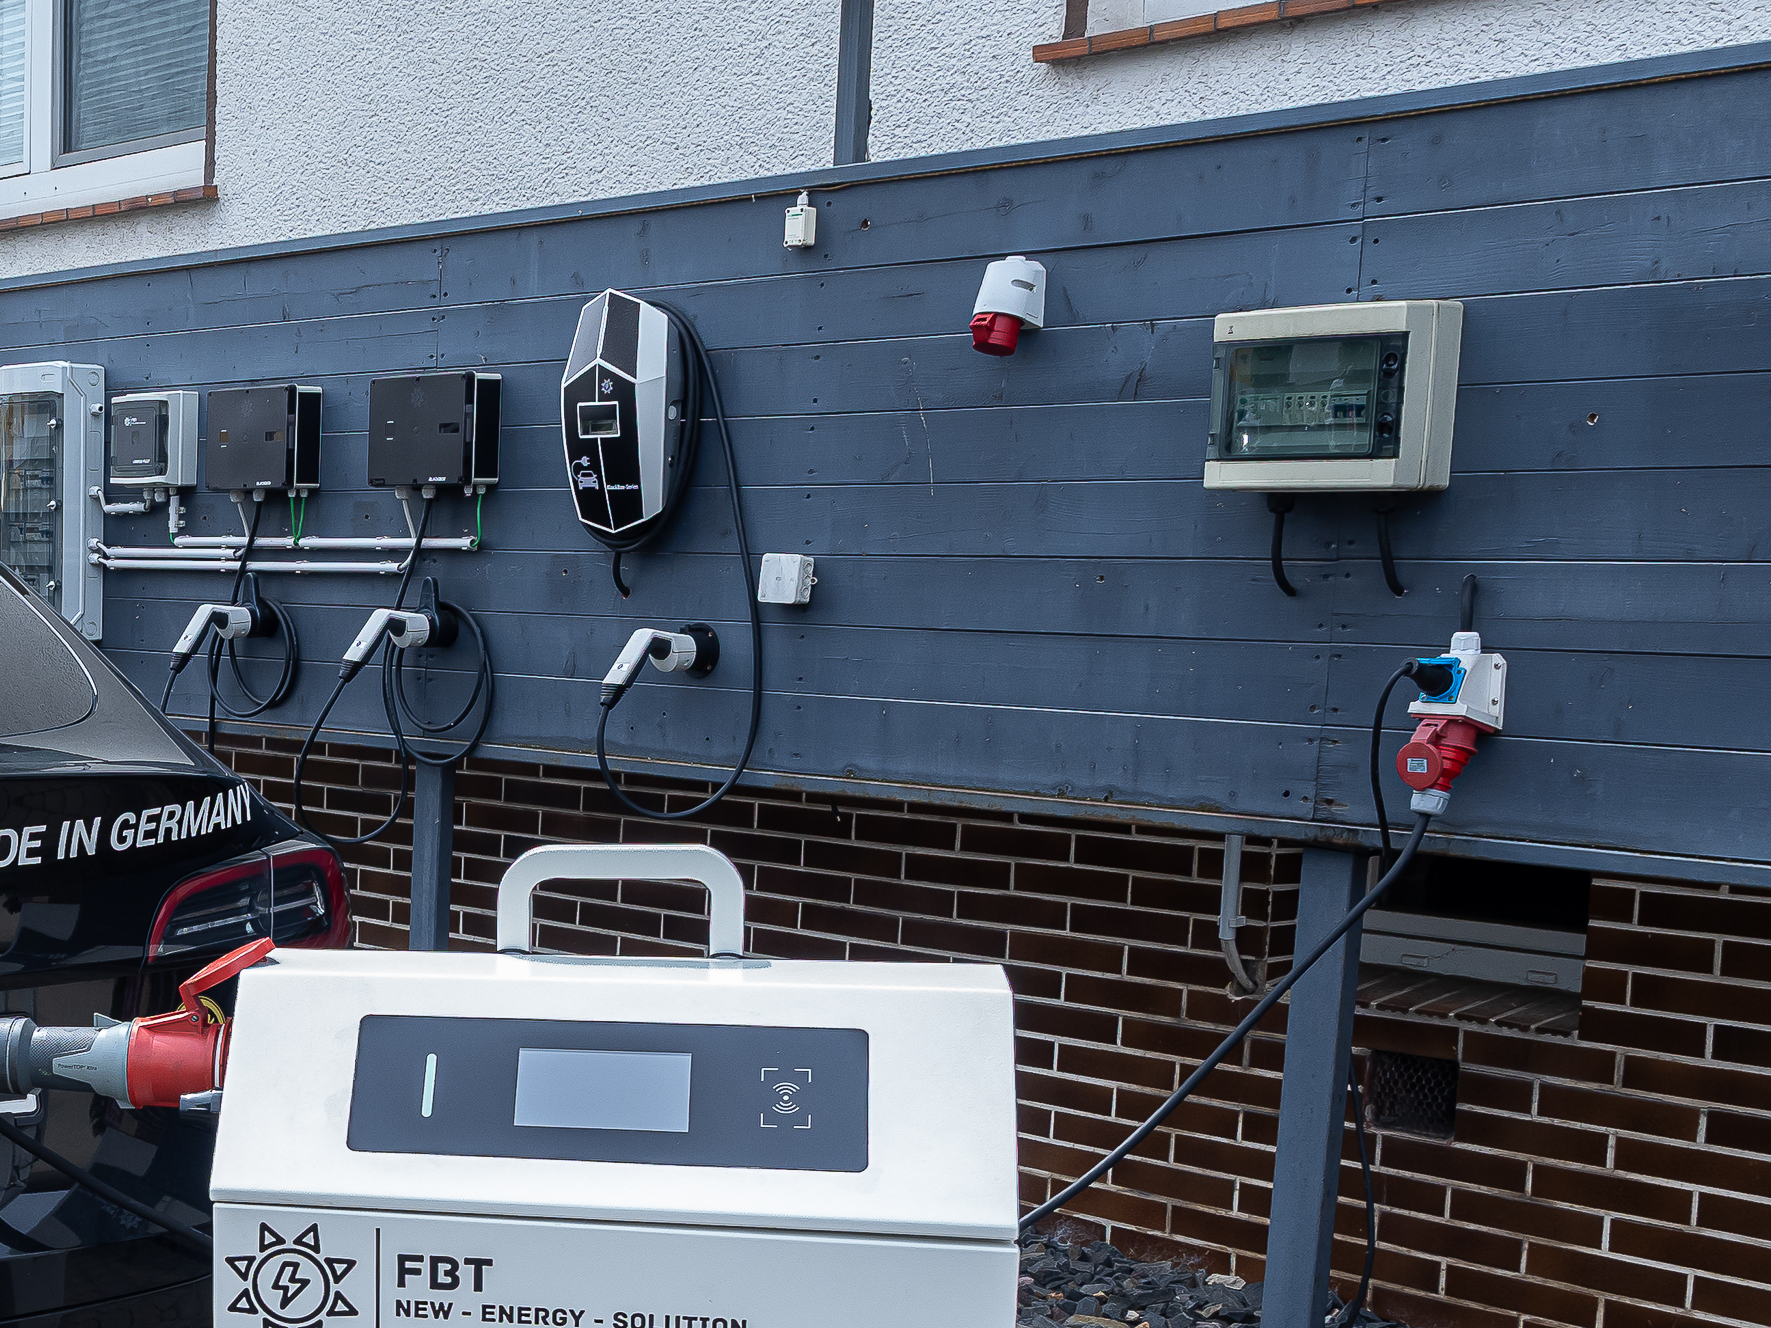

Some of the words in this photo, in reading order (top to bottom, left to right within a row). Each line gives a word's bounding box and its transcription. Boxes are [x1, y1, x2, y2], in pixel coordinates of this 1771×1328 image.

[57, 817, 102, 860] IN
[110, 782, 252, 852] GERMANY
[396, 1253, 493, 1293] FBT
[395, 1300, 453, 1320] NEW
[481, 1304, 586, 1328] ENERGY
